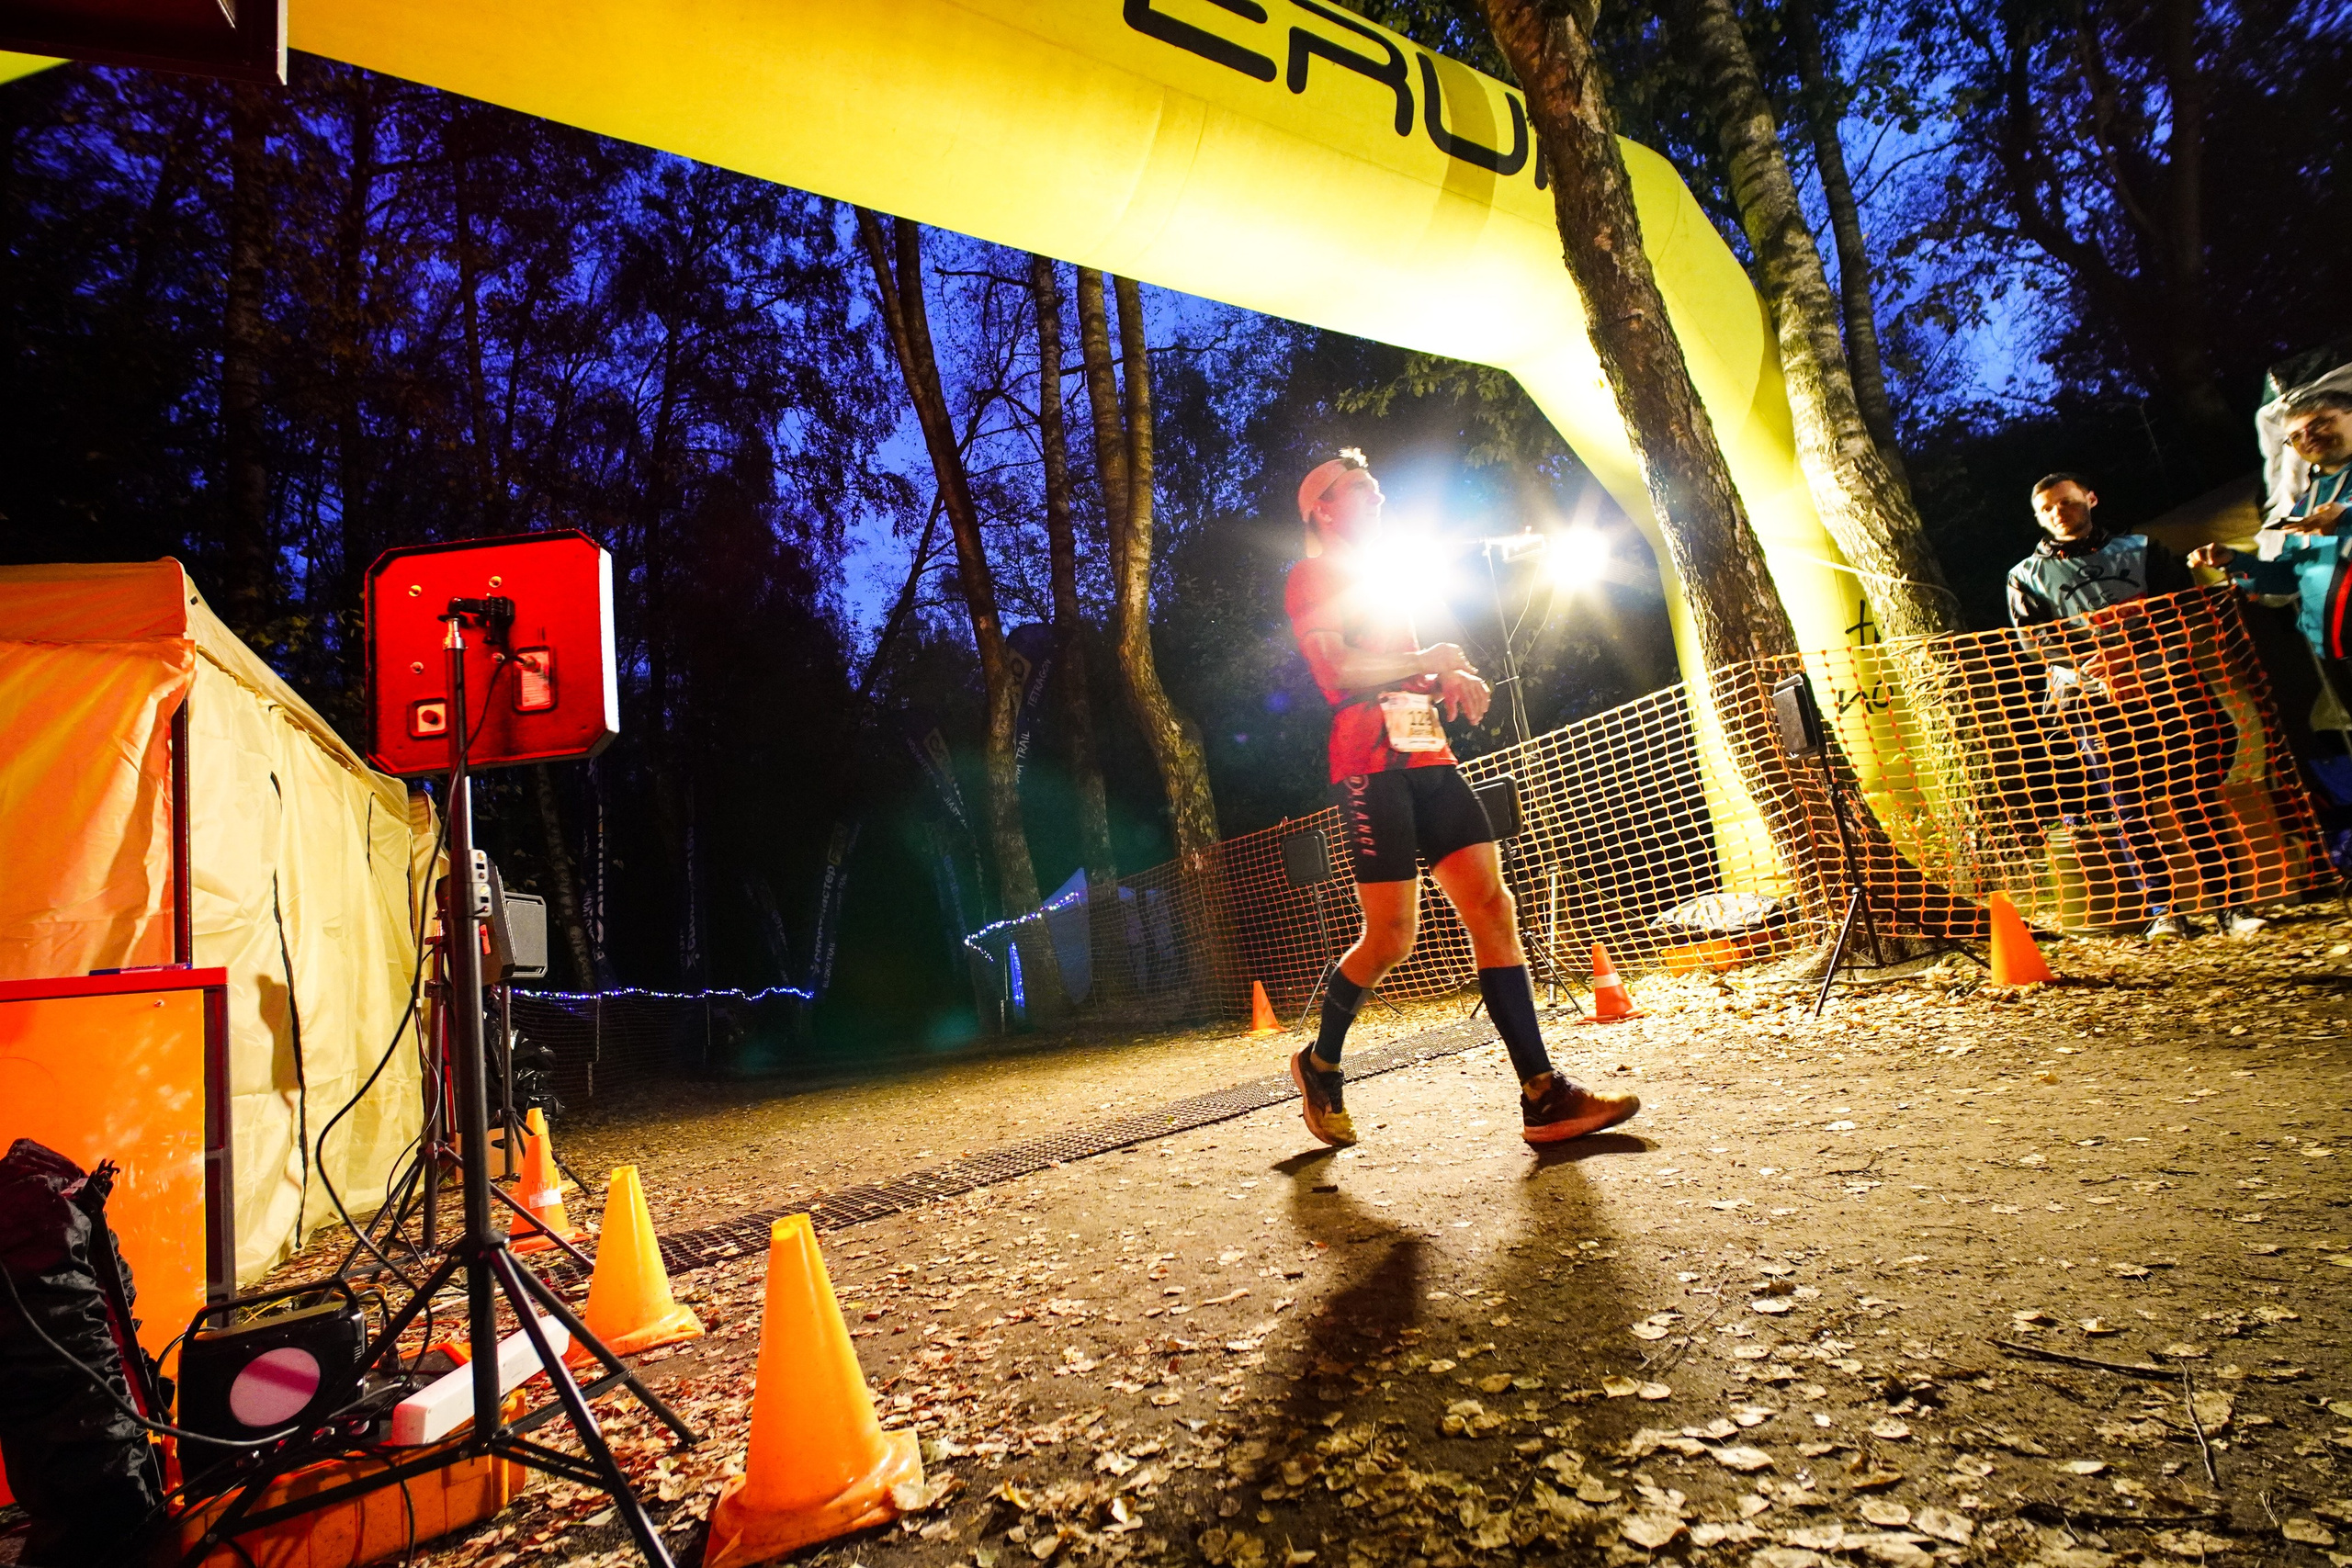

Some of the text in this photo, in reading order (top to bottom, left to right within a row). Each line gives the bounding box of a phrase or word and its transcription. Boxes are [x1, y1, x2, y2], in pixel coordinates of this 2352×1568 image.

[1124, 0, 1548, 190] ERU
[1015, 730, 1030, 761] TRAIL
[1027, 658, 1052, 708] TETRAGON
